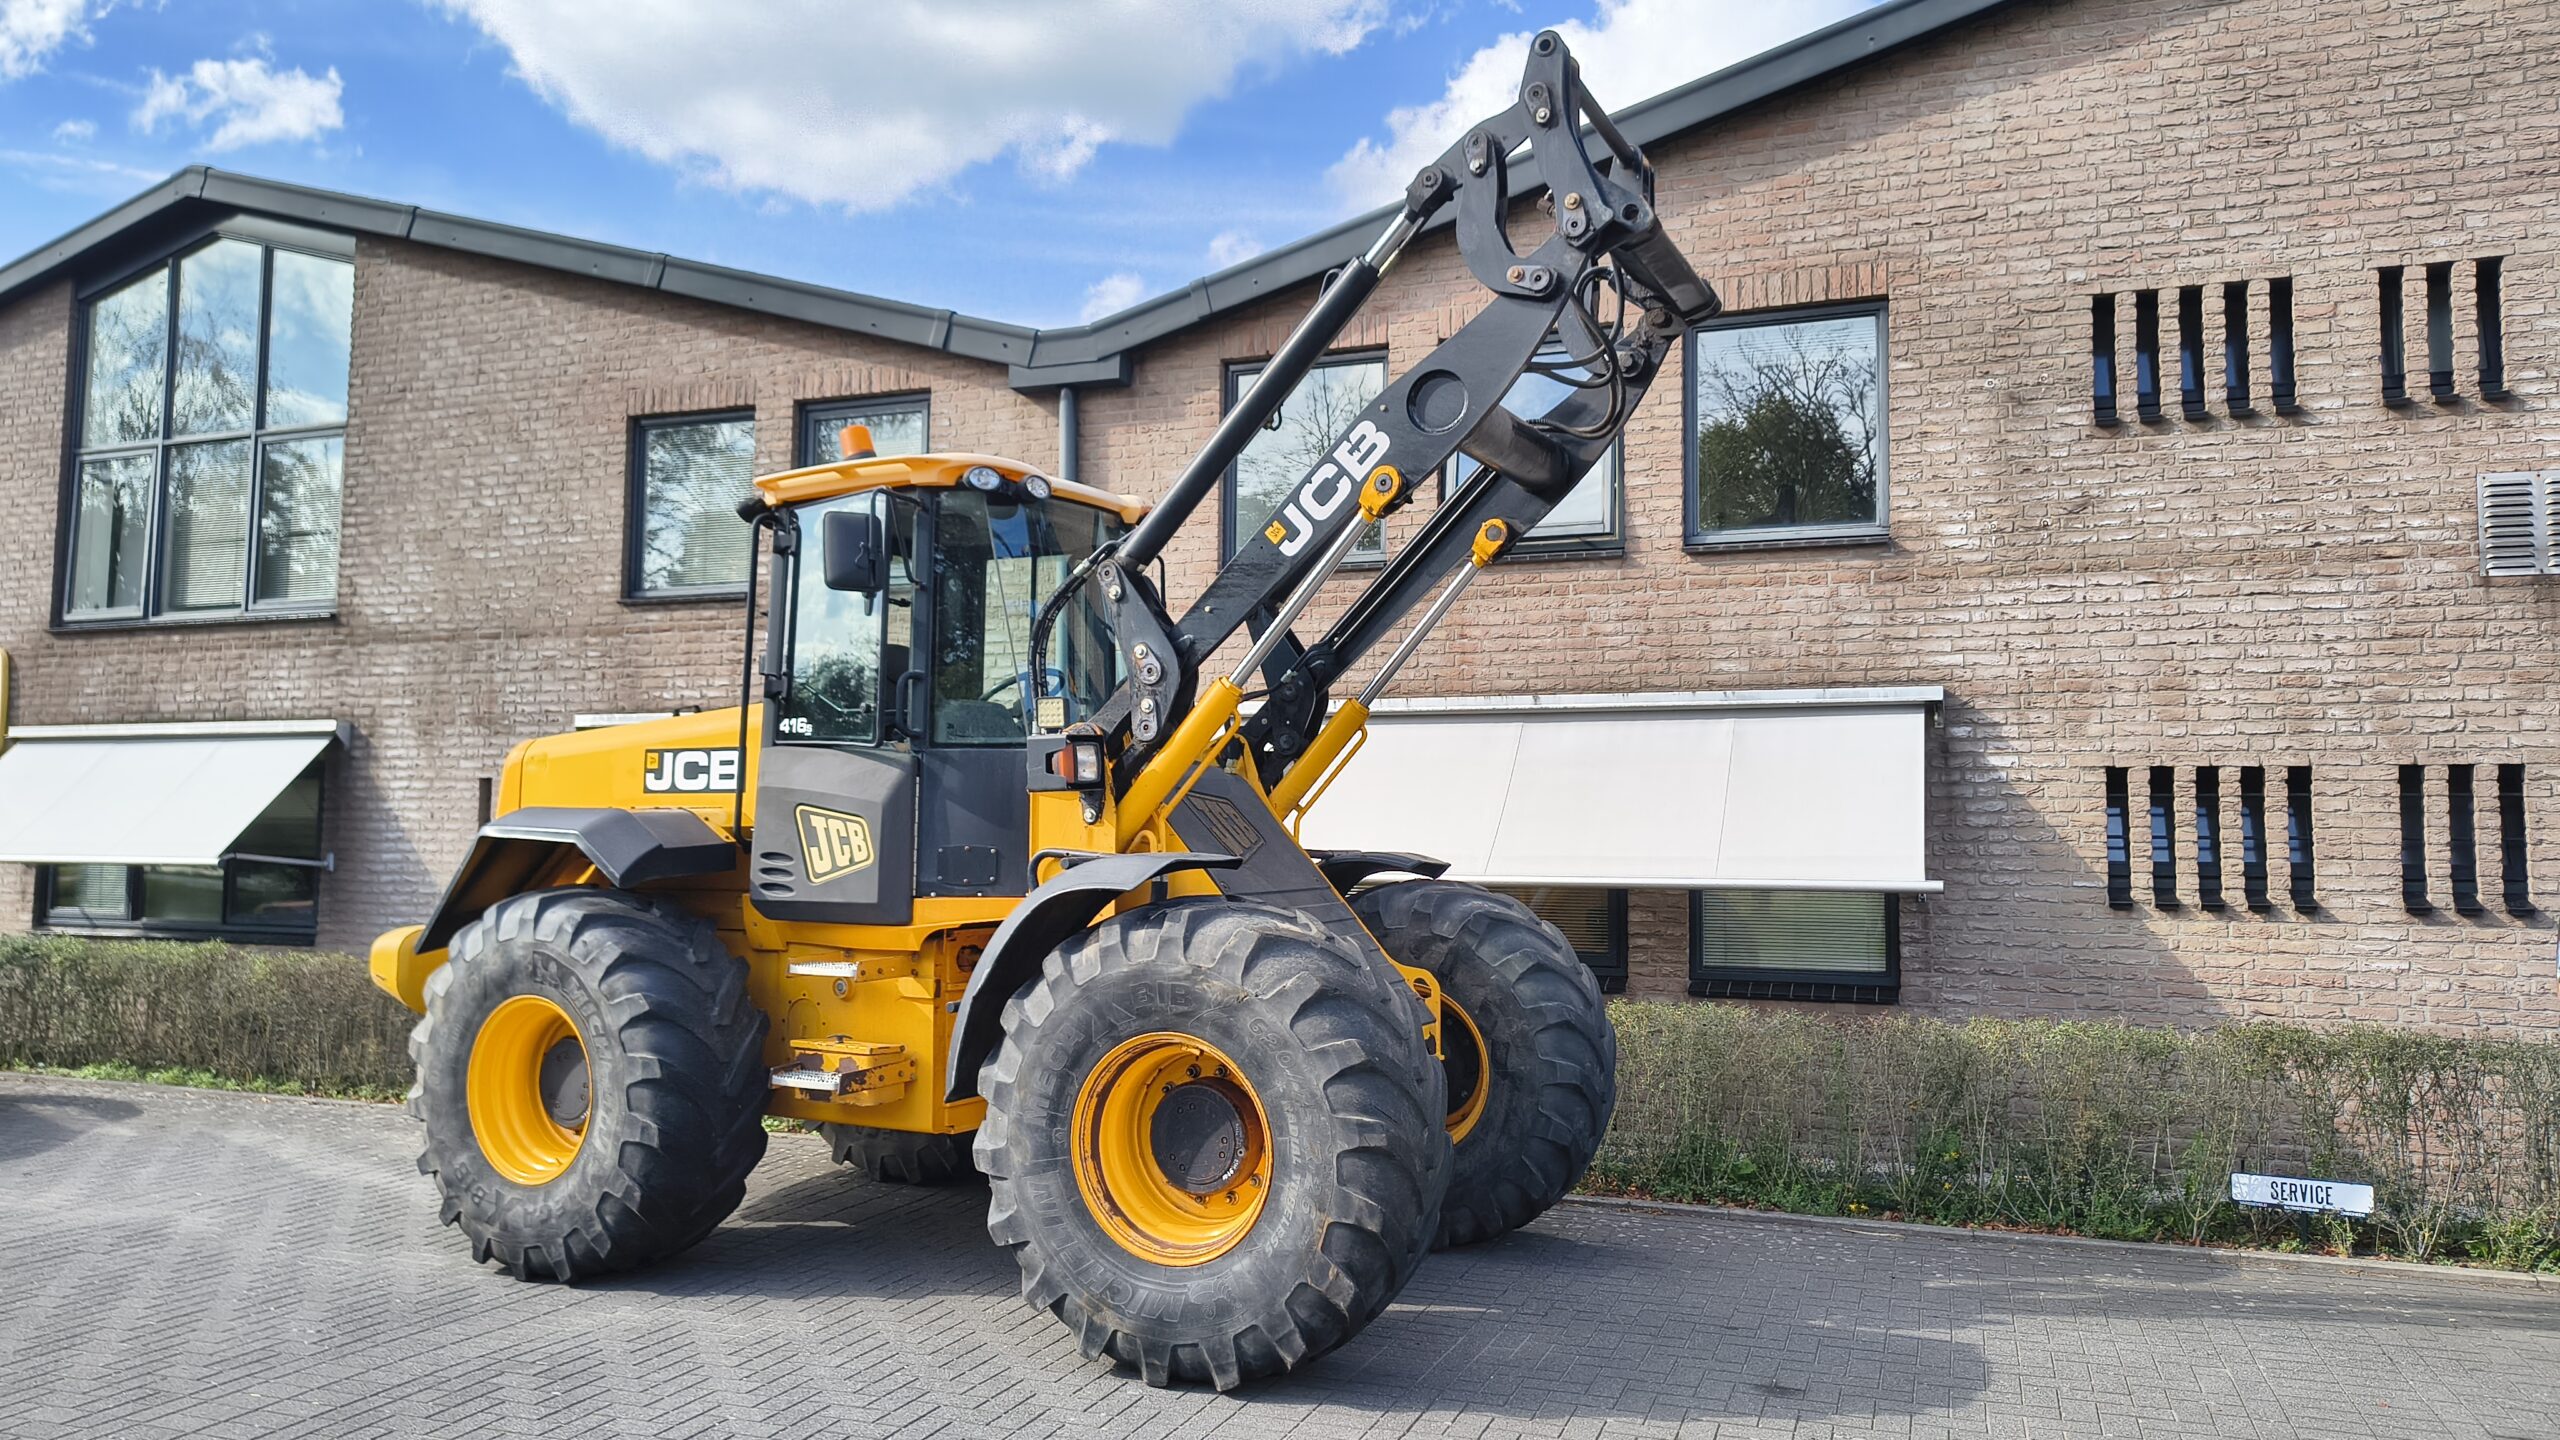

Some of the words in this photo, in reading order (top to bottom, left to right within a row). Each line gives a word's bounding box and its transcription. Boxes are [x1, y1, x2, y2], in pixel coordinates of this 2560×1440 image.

[1279, 420, 1390, 556] JCB
[645, 750, 740, 791] JCB
[808, 814, 869, 873] JCB
[2270, 1180, 2334, 1206] SERVICE
